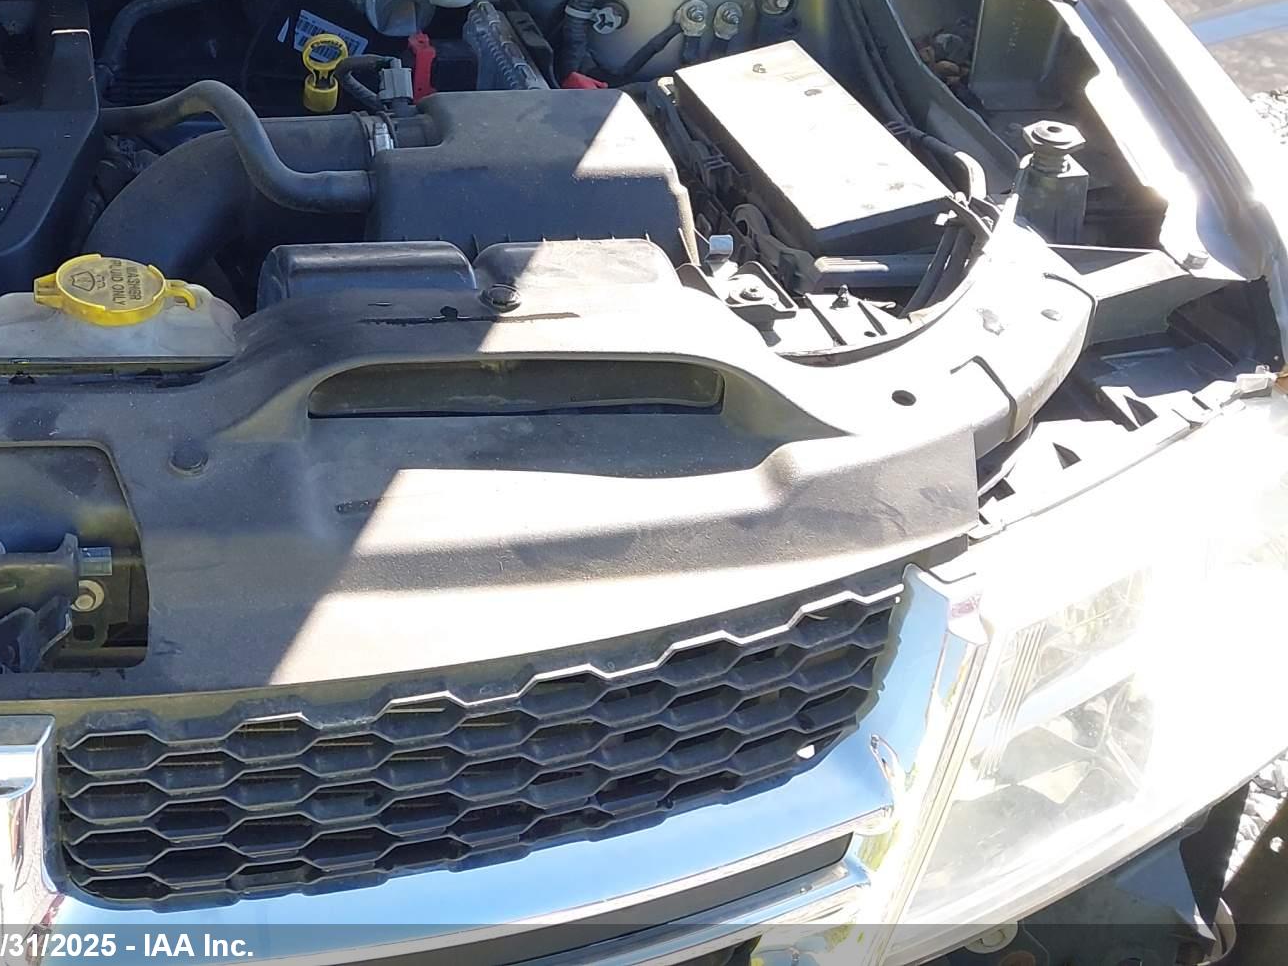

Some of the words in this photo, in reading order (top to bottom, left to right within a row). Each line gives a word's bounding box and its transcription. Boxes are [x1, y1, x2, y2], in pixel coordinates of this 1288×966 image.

[109, 259, 123, 284] FLUID
[126, 266, 143, 301] WASHER
[112, 284, 127, 306] ONLY
